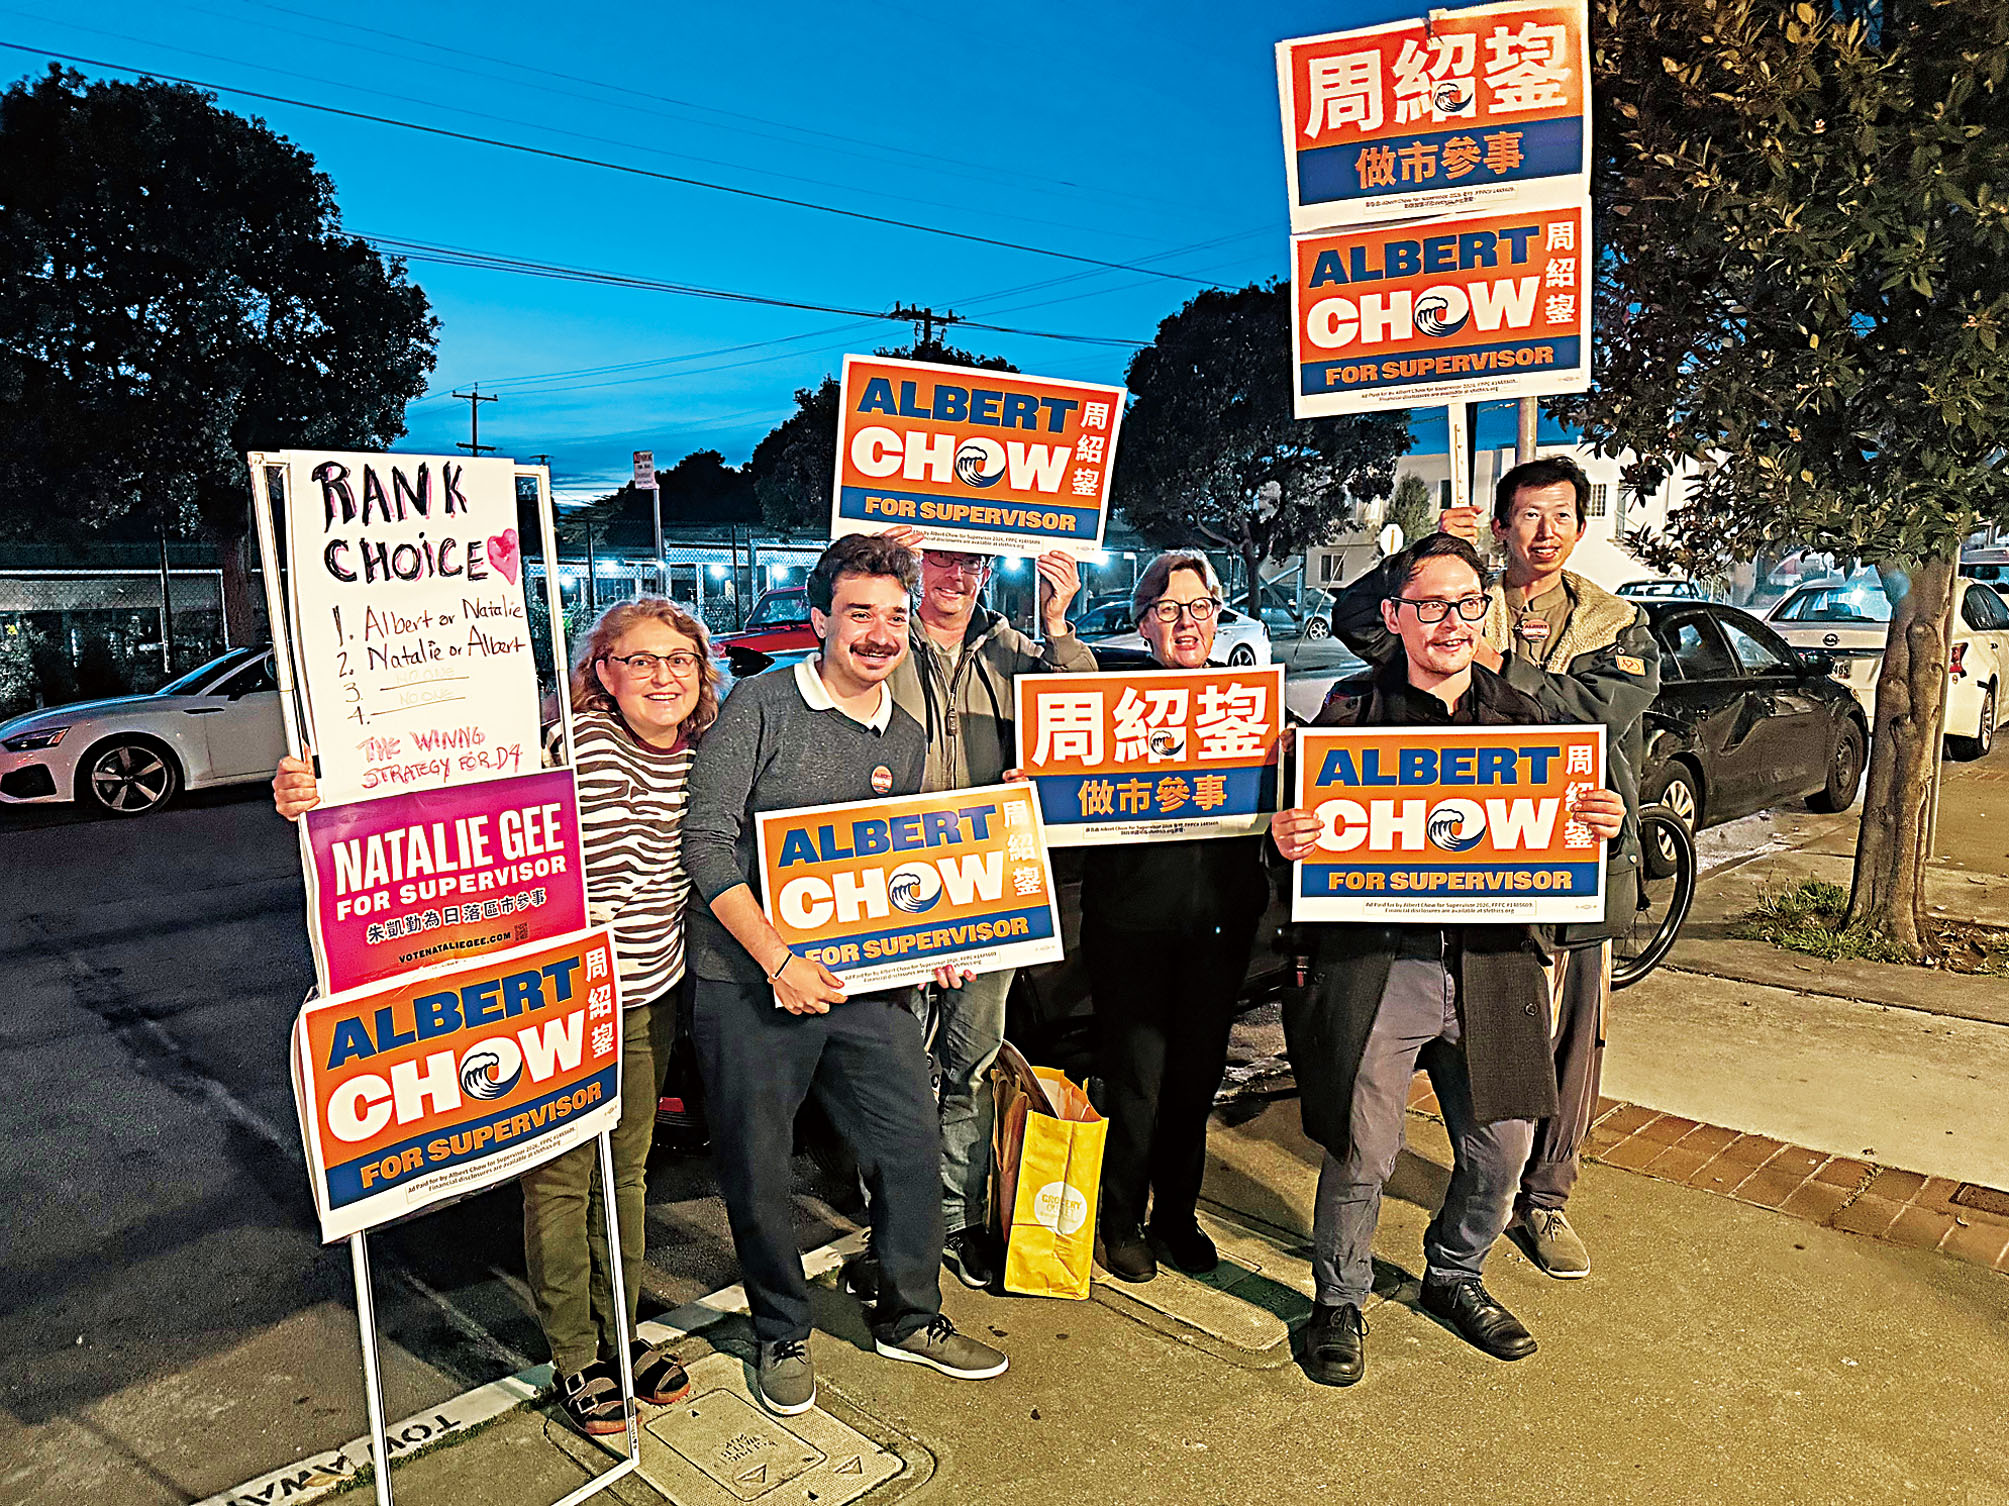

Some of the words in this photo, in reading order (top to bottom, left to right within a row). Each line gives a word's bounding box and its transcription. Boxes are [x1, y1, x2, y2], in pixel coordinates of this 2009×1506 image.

[1355, 131, 1524, 189] 做市參事
[1309, 226, 1540, 288] ALBERT
[1307, 276, 1541, 349] CHOW
[1326, 365, 1378, 386] FOR
[1382, 346, 1554, 380] SUPERVISOR
[858, 378, 1078, 433] ALBERT
[851, 426, 1072, 493] CHOW
[312, 461, 467, 532] RANK
[865, 496, 916, 518] FOR
[920, 501, 1076, 531] SUPERVISOR
[332, 605, 354, 646] 1.
[365, 606, 432, 641] Albert
[440, 614, 454, 626] or
[463, 595, 523, 620] Natalie
[337, 653, 354, 677] 2.
[368, 641, 445, 670] Natalie
[449, 645, 462, 656] or
[468, 625, 526, 657] Albert
[344, 683, 363, 702] 3.
[348, 706, 370, 725] 4.
[356, 736, 400, 762] THE
[361, 758, 450, 788] STRATEGY
[496, 744, 522, 772] D4
[1316, 746, 1560, 786] ALBERT
[1078, 775, 1228, 816] 做市參事
[332, 815, 493, 896] NATALIE
[500, 802, 565, 861] GEE
[779, 804, 996, 868] ALBERT
[1314, 798, 1560, 852] CHOW
[337, 891, 390, 921] FOR
[400, 855, 566, 904] SUPERVISOR
[779, 851, 1004, 930] CHOW
[1328, 871, 1385, 890] FOR
[1390, 871, 1572, 890] SUPERVISOR
[367, 888, 546, 944] 朱凱勤為日落區市參事
[805, 944, 860, 966] FOR
[863, 917, 1028, 960] SUPERVISOR
[399, 931, 511, 963] VOTENATALIEGEE.COM
[326, 956, 580, 1071] ALBERT
[327, 1008, 585, 1144] CHOW
[361, 1146, 424, 1188] FOR
[428, 1082, 602, 1162] SUPERVISOR
[469, 1164, 486, 1173] Chow
[1041, 1194, 1082, 1210] GROERY
